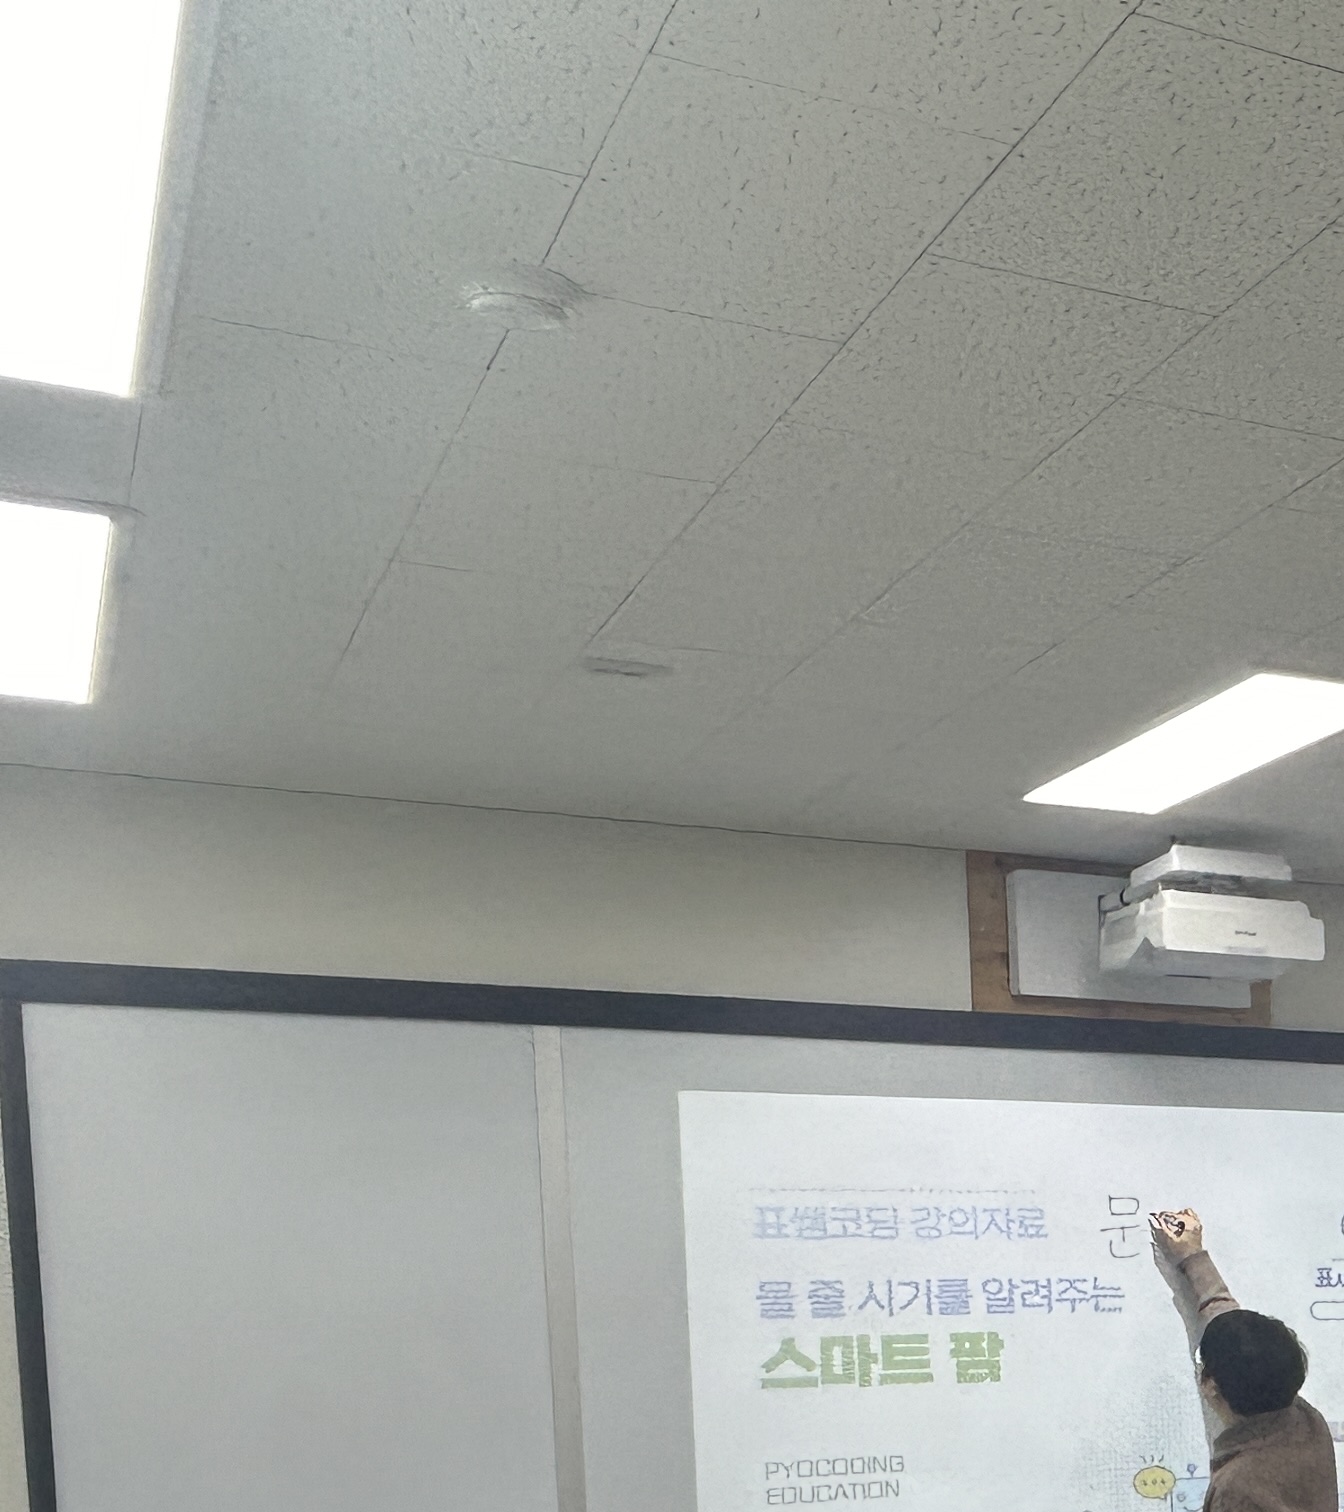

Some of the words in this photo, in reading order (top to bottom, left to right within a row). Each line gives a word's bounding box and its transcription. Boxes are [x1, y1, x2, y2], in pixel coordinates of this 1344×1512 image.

[910, 1204, 1049, 1240] 강의자료
[756, 1280, 798, 1320] 물
[808, 1279, 847, 1320] 줄
[857, 1278, 973, 1318] 시기를
[981, 1276, 1125, 1315] 알려주는
[760, 1333, 934, 1389] 스마트
[765, 1455, 905, 1481] PYOCODING
[766, 1480, 900, 1505] EDUCATION
